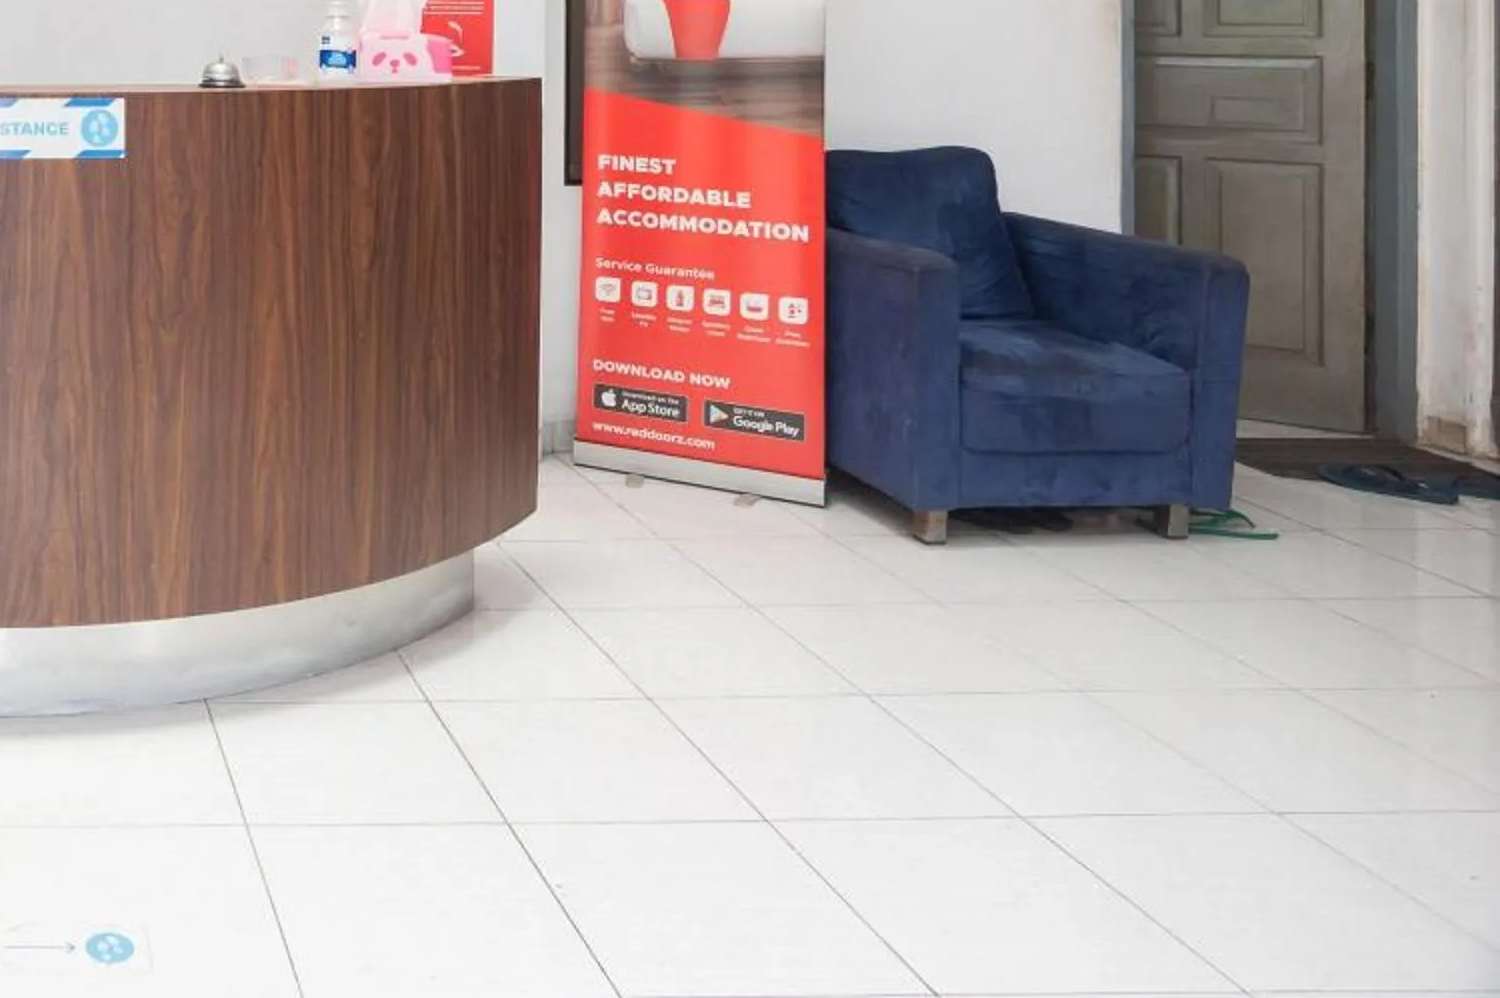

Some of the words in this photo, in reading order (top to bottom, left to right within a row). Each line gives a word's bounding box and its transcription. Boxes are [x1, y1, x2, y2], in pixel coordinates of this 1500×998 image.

[597, 153, 676, 175] FINEST
[597, 181, 751, 209] AFFORDABLE
[596, 208, 810, 243] ACCOMMODATION
[595, 257, 642, 274] Service
[645, 262, 716, 281] Guarantee
[592, 358, 686, 384] DOWNLOAD
[689, 373, 731, 390] NOW
[621, 399, 647, 414] App
[648, 403, 680, 418] Store
[733, 415, 775, 433] Google
[775, 421, 800, 438] Play
